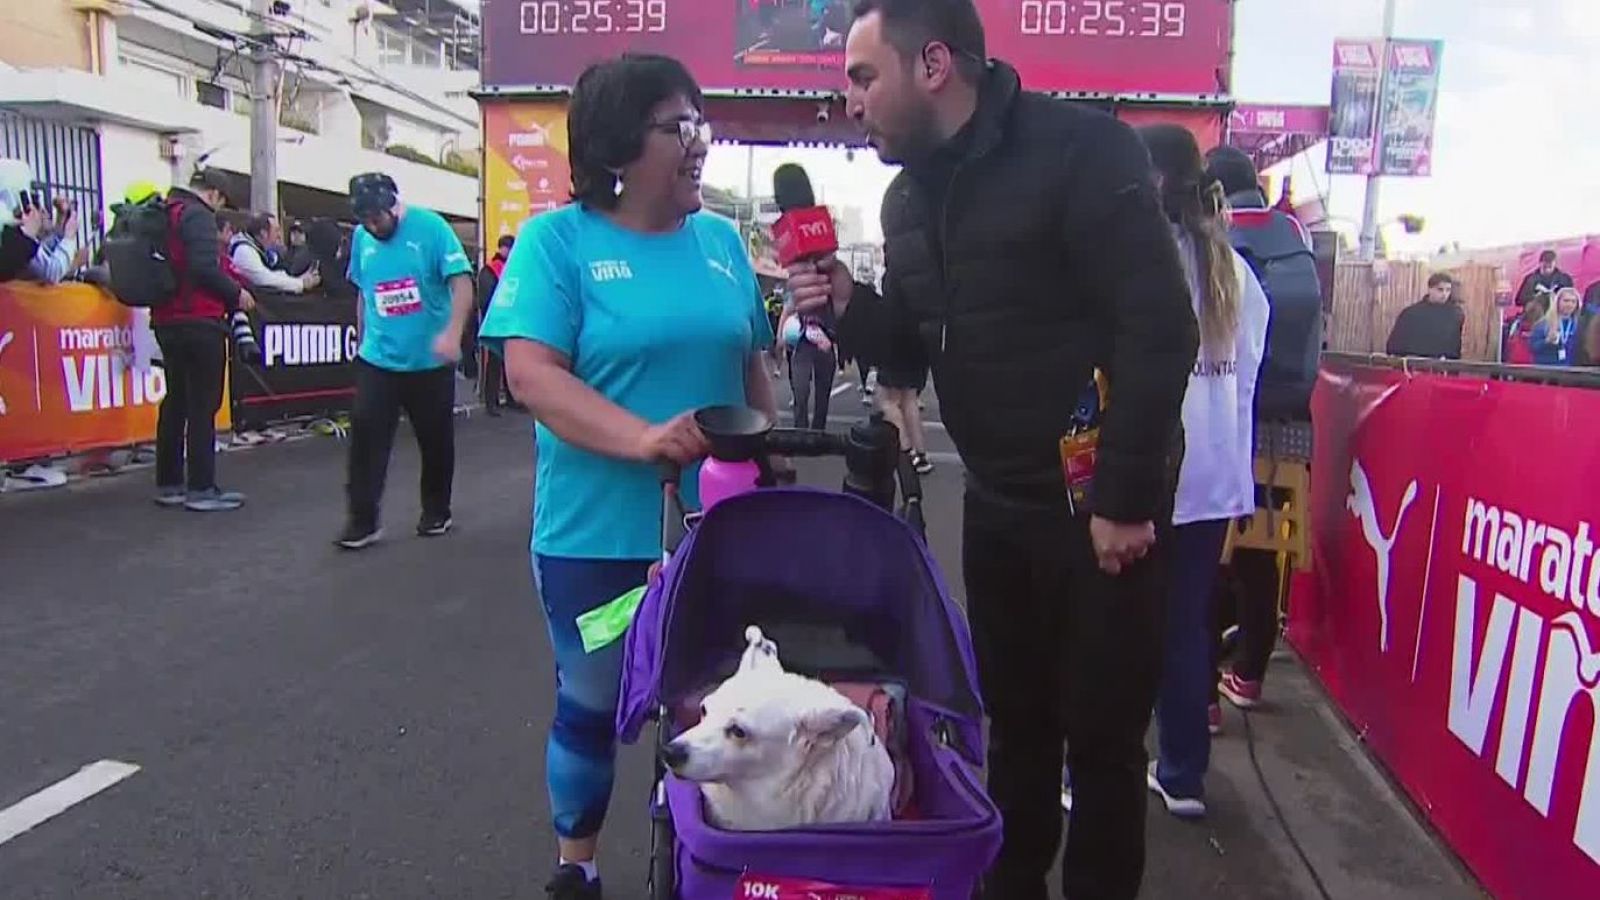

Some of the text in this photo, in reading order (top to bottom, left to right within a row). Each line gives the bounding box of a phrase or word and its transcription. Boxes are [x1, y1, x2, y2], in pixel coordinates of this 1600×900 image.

[520, 0, 666, 33] 00:25:39
[1020, 0, 1185, 36] 00:25:39
[265, 324, 341, 366] PUMA
[743, 881, 780, 899] 10K
